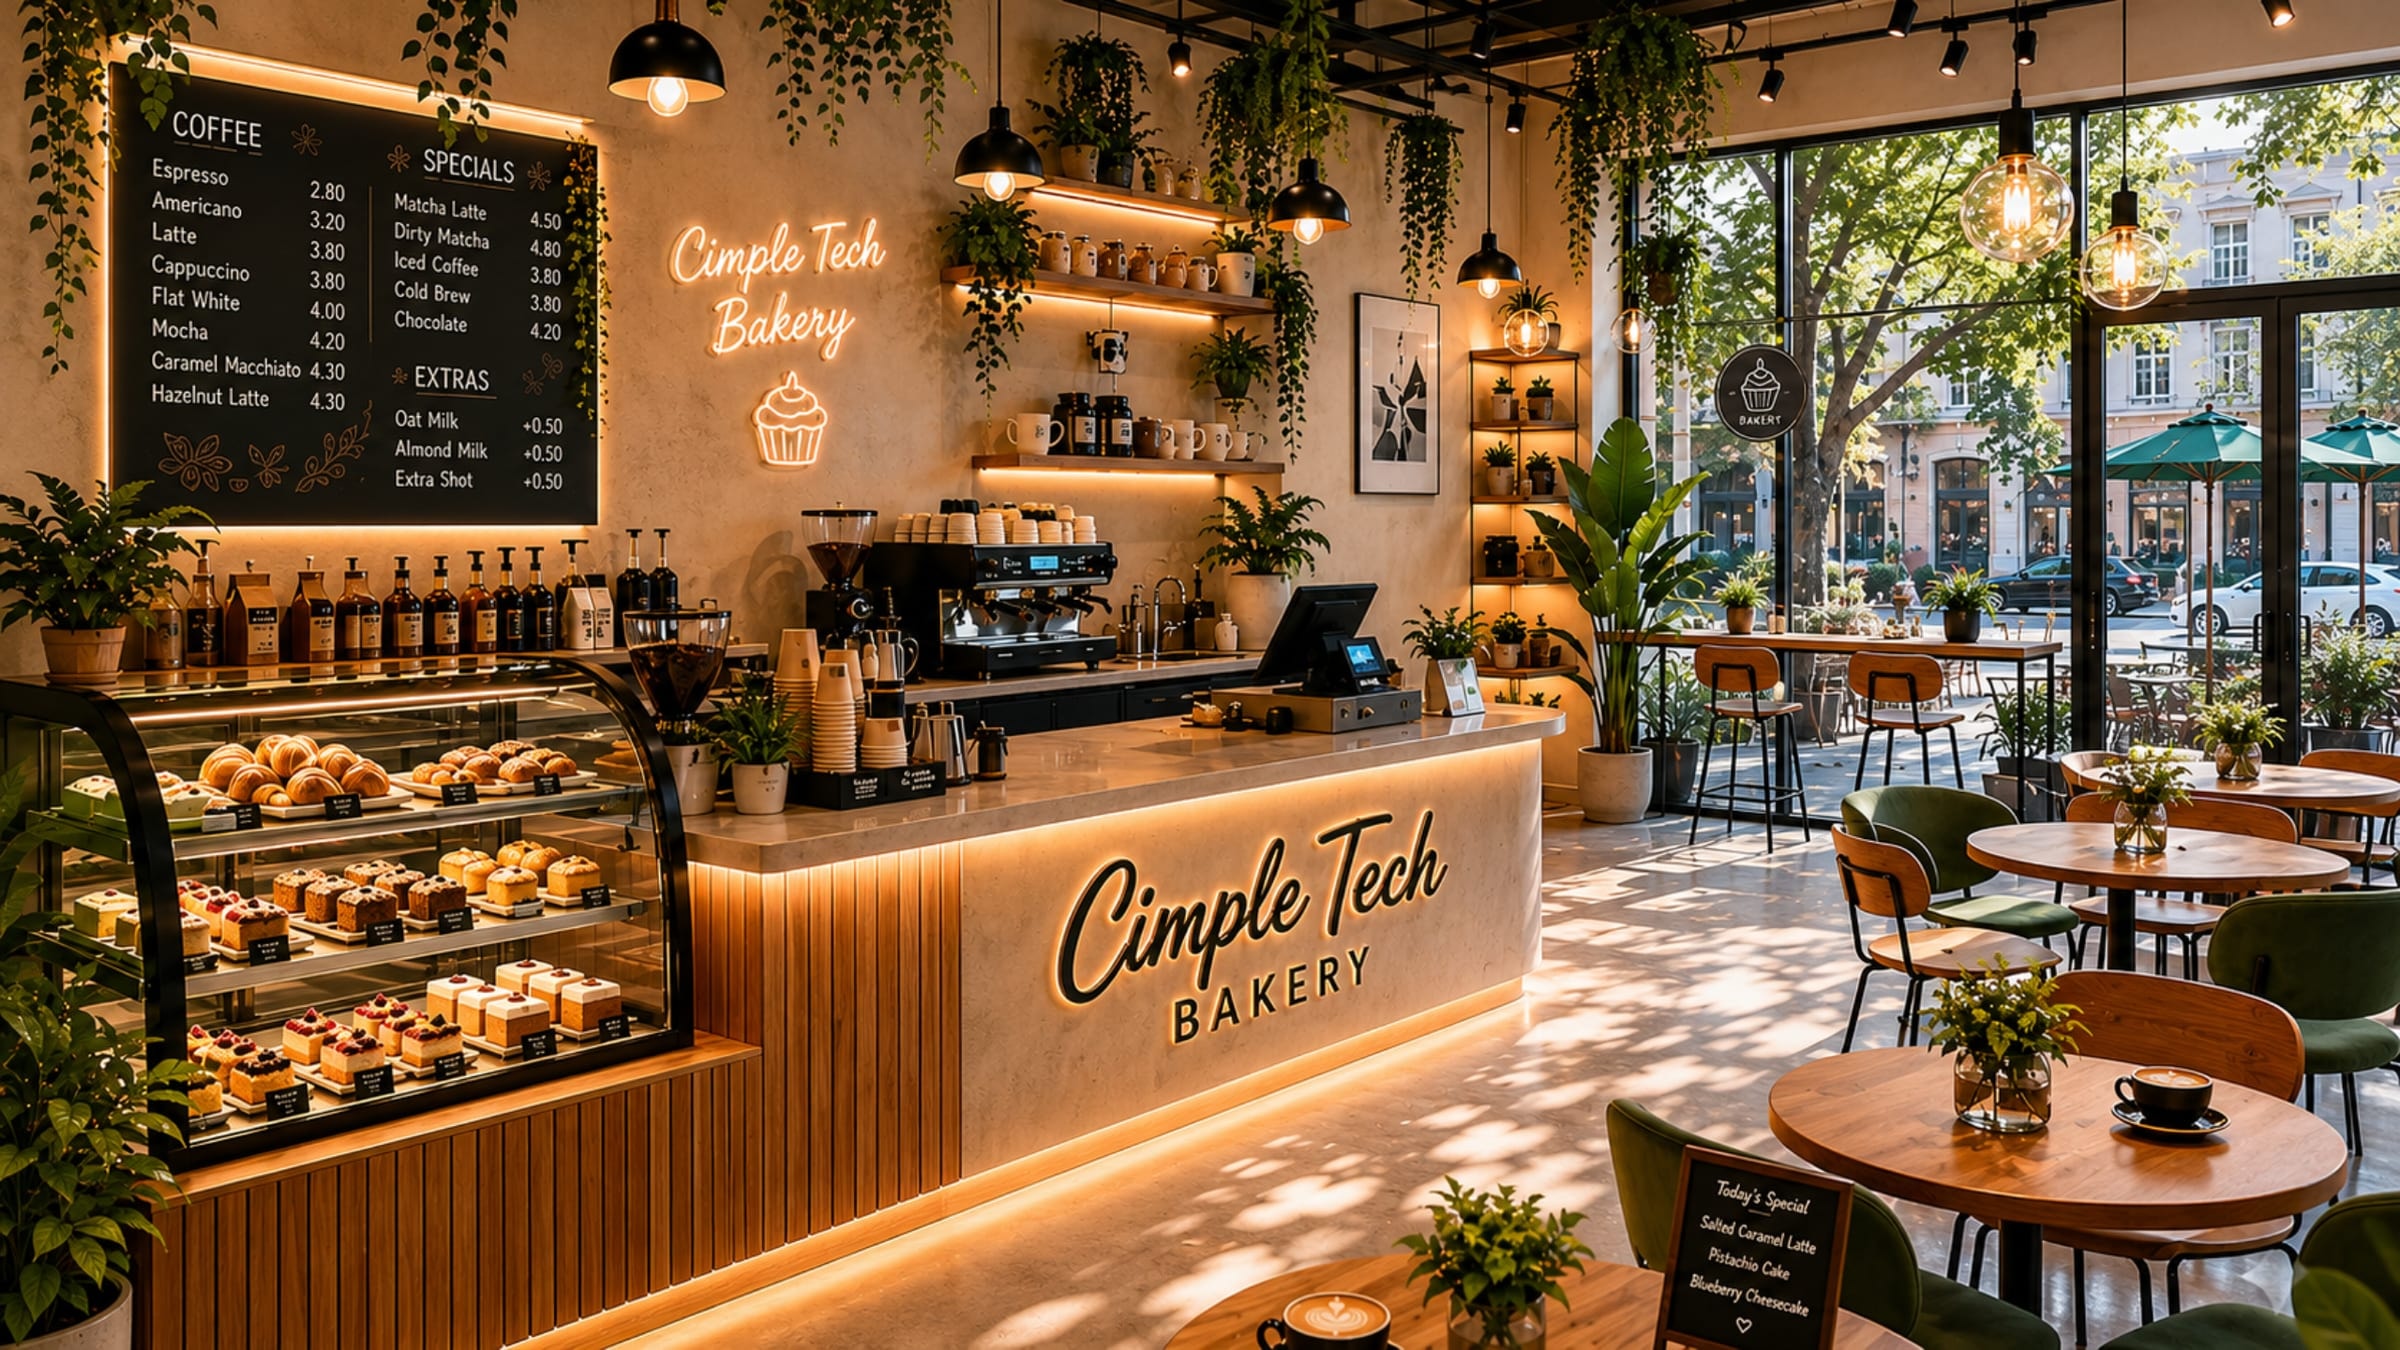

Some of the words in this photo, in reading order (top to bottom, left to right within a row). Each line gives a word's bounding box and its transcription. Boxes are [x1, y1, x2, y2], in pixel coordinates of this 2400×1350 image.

[172, 111, 262, 149] COFFEE
[152, 157, 229, 186] Espresso
[310, 180, 346, 202] 2.80
[423, 150, 515, 184] SPECIALS
[151, 190, 242, 219] Americano
[310, 210, 346, 232] 3.20
[394, 192, 446, 216] Matcha
[451, 200, 487, 221] Latte
[530, 211, 562, 231] 4.50
[152, 221, 197, 245] Latte
[310, 240, 345, 262] 3.80
[394, 221, 432, 247] Dirty
[437, 227, 490, 250] Matcha
[530, 239, 561, 258] 4.80
[670, 221, 805, 293] Cimple
[811, 218, 886, 273] Tech
[151, 253, 250, 282] Cappuccino
[309, 270, 346, 291] 3.80
[394, 250, 426, 271] Iced
[431, 255, 479, 278] Coffee
[530, 266, 561, 286] 3.80
[152, 285, 185, 307] Flat
[191, 289, 241, 312] White
[309, 301, 346, 321] 4.00
[394, 280, 428, 300] Cold
[434, 284, 471, 304] Brew
[530, 294, 562, 314] 3.80
[152, 317, 209, 341] Mocha
[309, 331, 345, 351] 4.20
[394, 310, 468, 333] Chocolate
[530, 322, 561, 341] 4.20
[711, 291, 855, 360] Bakery
[151, 350, 218, 373] Caramel
[225, 355, 302, 378] Macchiato
[309, 362, 346, 381] 4.30
[415, 365, 490, 392] EXTRAS
[152, 383, 223, 406] Hazelnut
[229, 387, 270, 407] Latte
[309, 392, 346, 411] 4.30
[395, 409, 422, 428] Oat
[428, 411, 459, 430] Milk
[523, 416, 563, 435] +0.50
[1739, 415, 1781, 425] BAKERY
[394, 439, 452, 458] Almond
[457, 441, 488, 459] Milk
[524, 444, 563, 463] +0.50
[395, 469, 435, 488] Extra
[440, 470, 473, 489] Shot
[523, 472, 563, 490] +0.50
[1057, 837, 1311, 1004] Cimple
[1317, 810, 1448, 936] Tech
[1173, 946, 1370, 1044] BAKERY
[1717, 1180, 1761, 1207] Today's
[1765, 1191, 1811, 1215] Special
[1700, 1215, 1736, 1236] Salted
[1738, 1225, 1784, 1247] Caramel
[1787, 1235, 1817, 1255] Latte
[1708, 1247, 1759, 1272] Pistachio
[1762, 1263, 1791, 1281] Cake
[1689, 1274, 1743, 1303] Blueberry
[1745, 1288, 1809, 1317] Cheesecake
